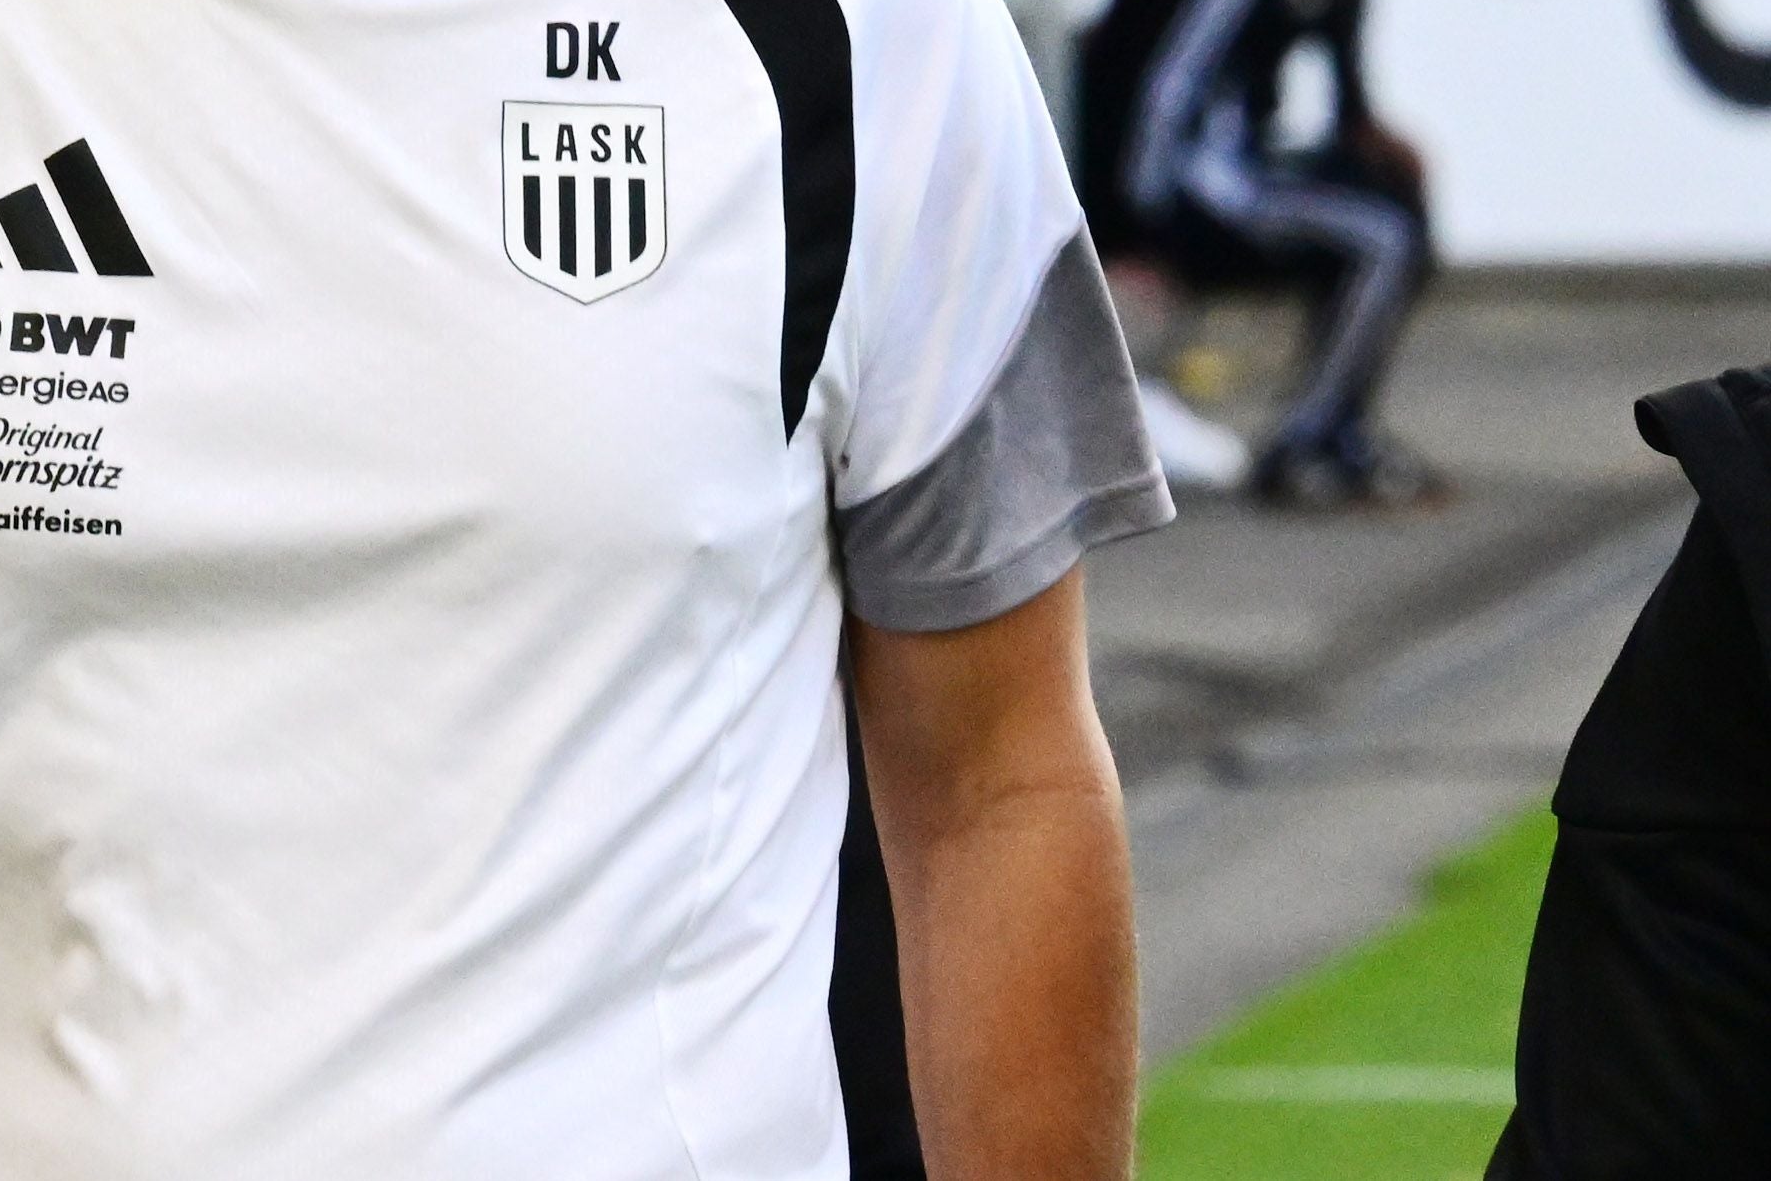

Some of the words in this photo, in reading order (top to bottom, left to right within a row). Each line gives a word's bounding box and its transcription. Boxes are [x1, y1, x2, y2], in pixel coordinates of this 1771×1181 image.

[545, 21, 621, 82] DK
[521, 122, 647, 165] LASK
[9, 312, 136, 359] BWT
